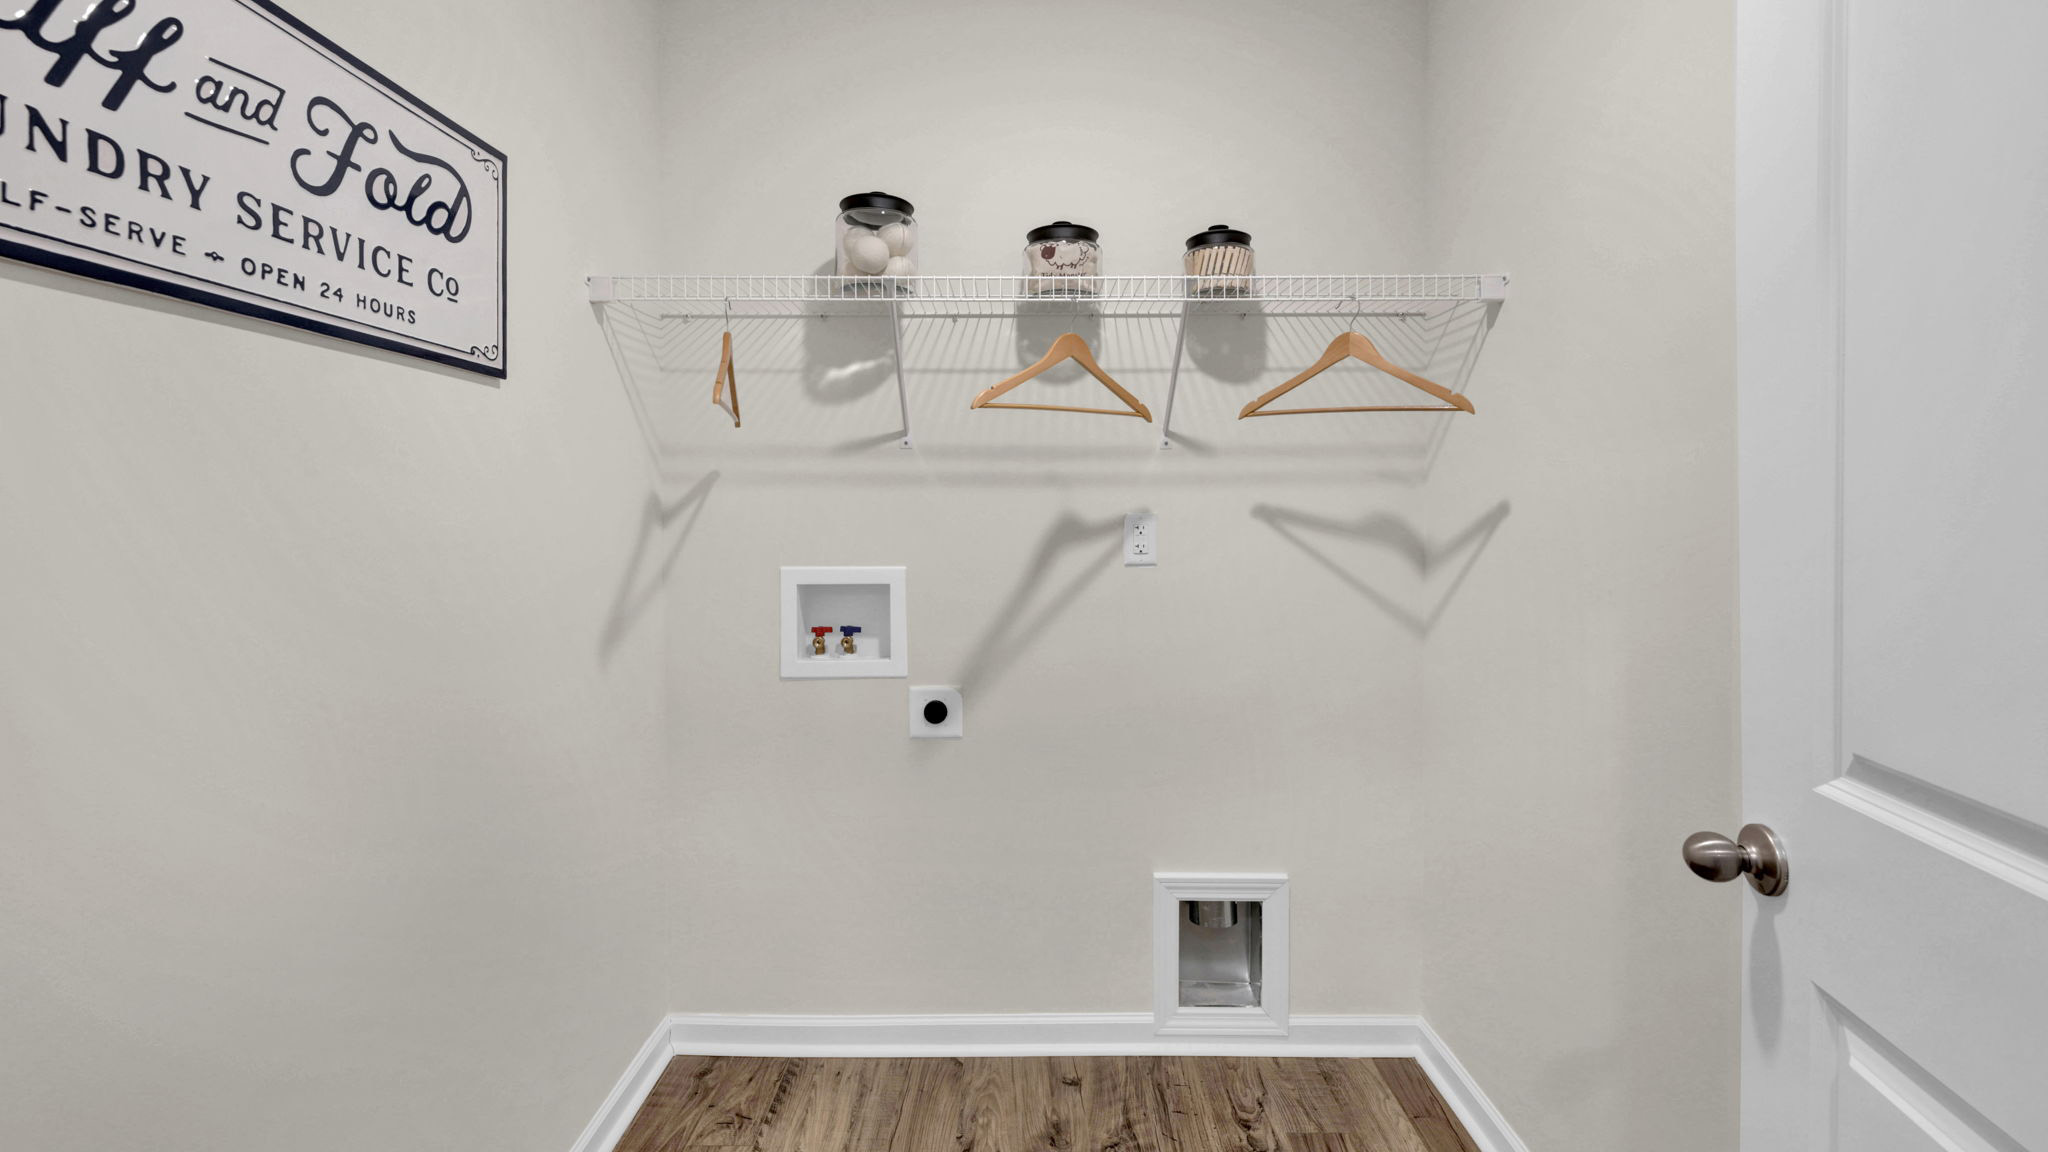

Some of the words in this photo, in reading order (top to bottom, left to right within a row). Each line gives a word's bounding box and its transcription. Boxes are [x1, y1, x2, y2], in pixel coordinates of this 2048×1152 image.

[195, 75, 286, 131] and
[291, 96, 472, 243] Fold
[237, 191, 414, 287] SERVICE
[241, 257, 305, 291] OPEN
[320, 282, 344, 302] 24
[356, 293, 416, 325] HOURS
